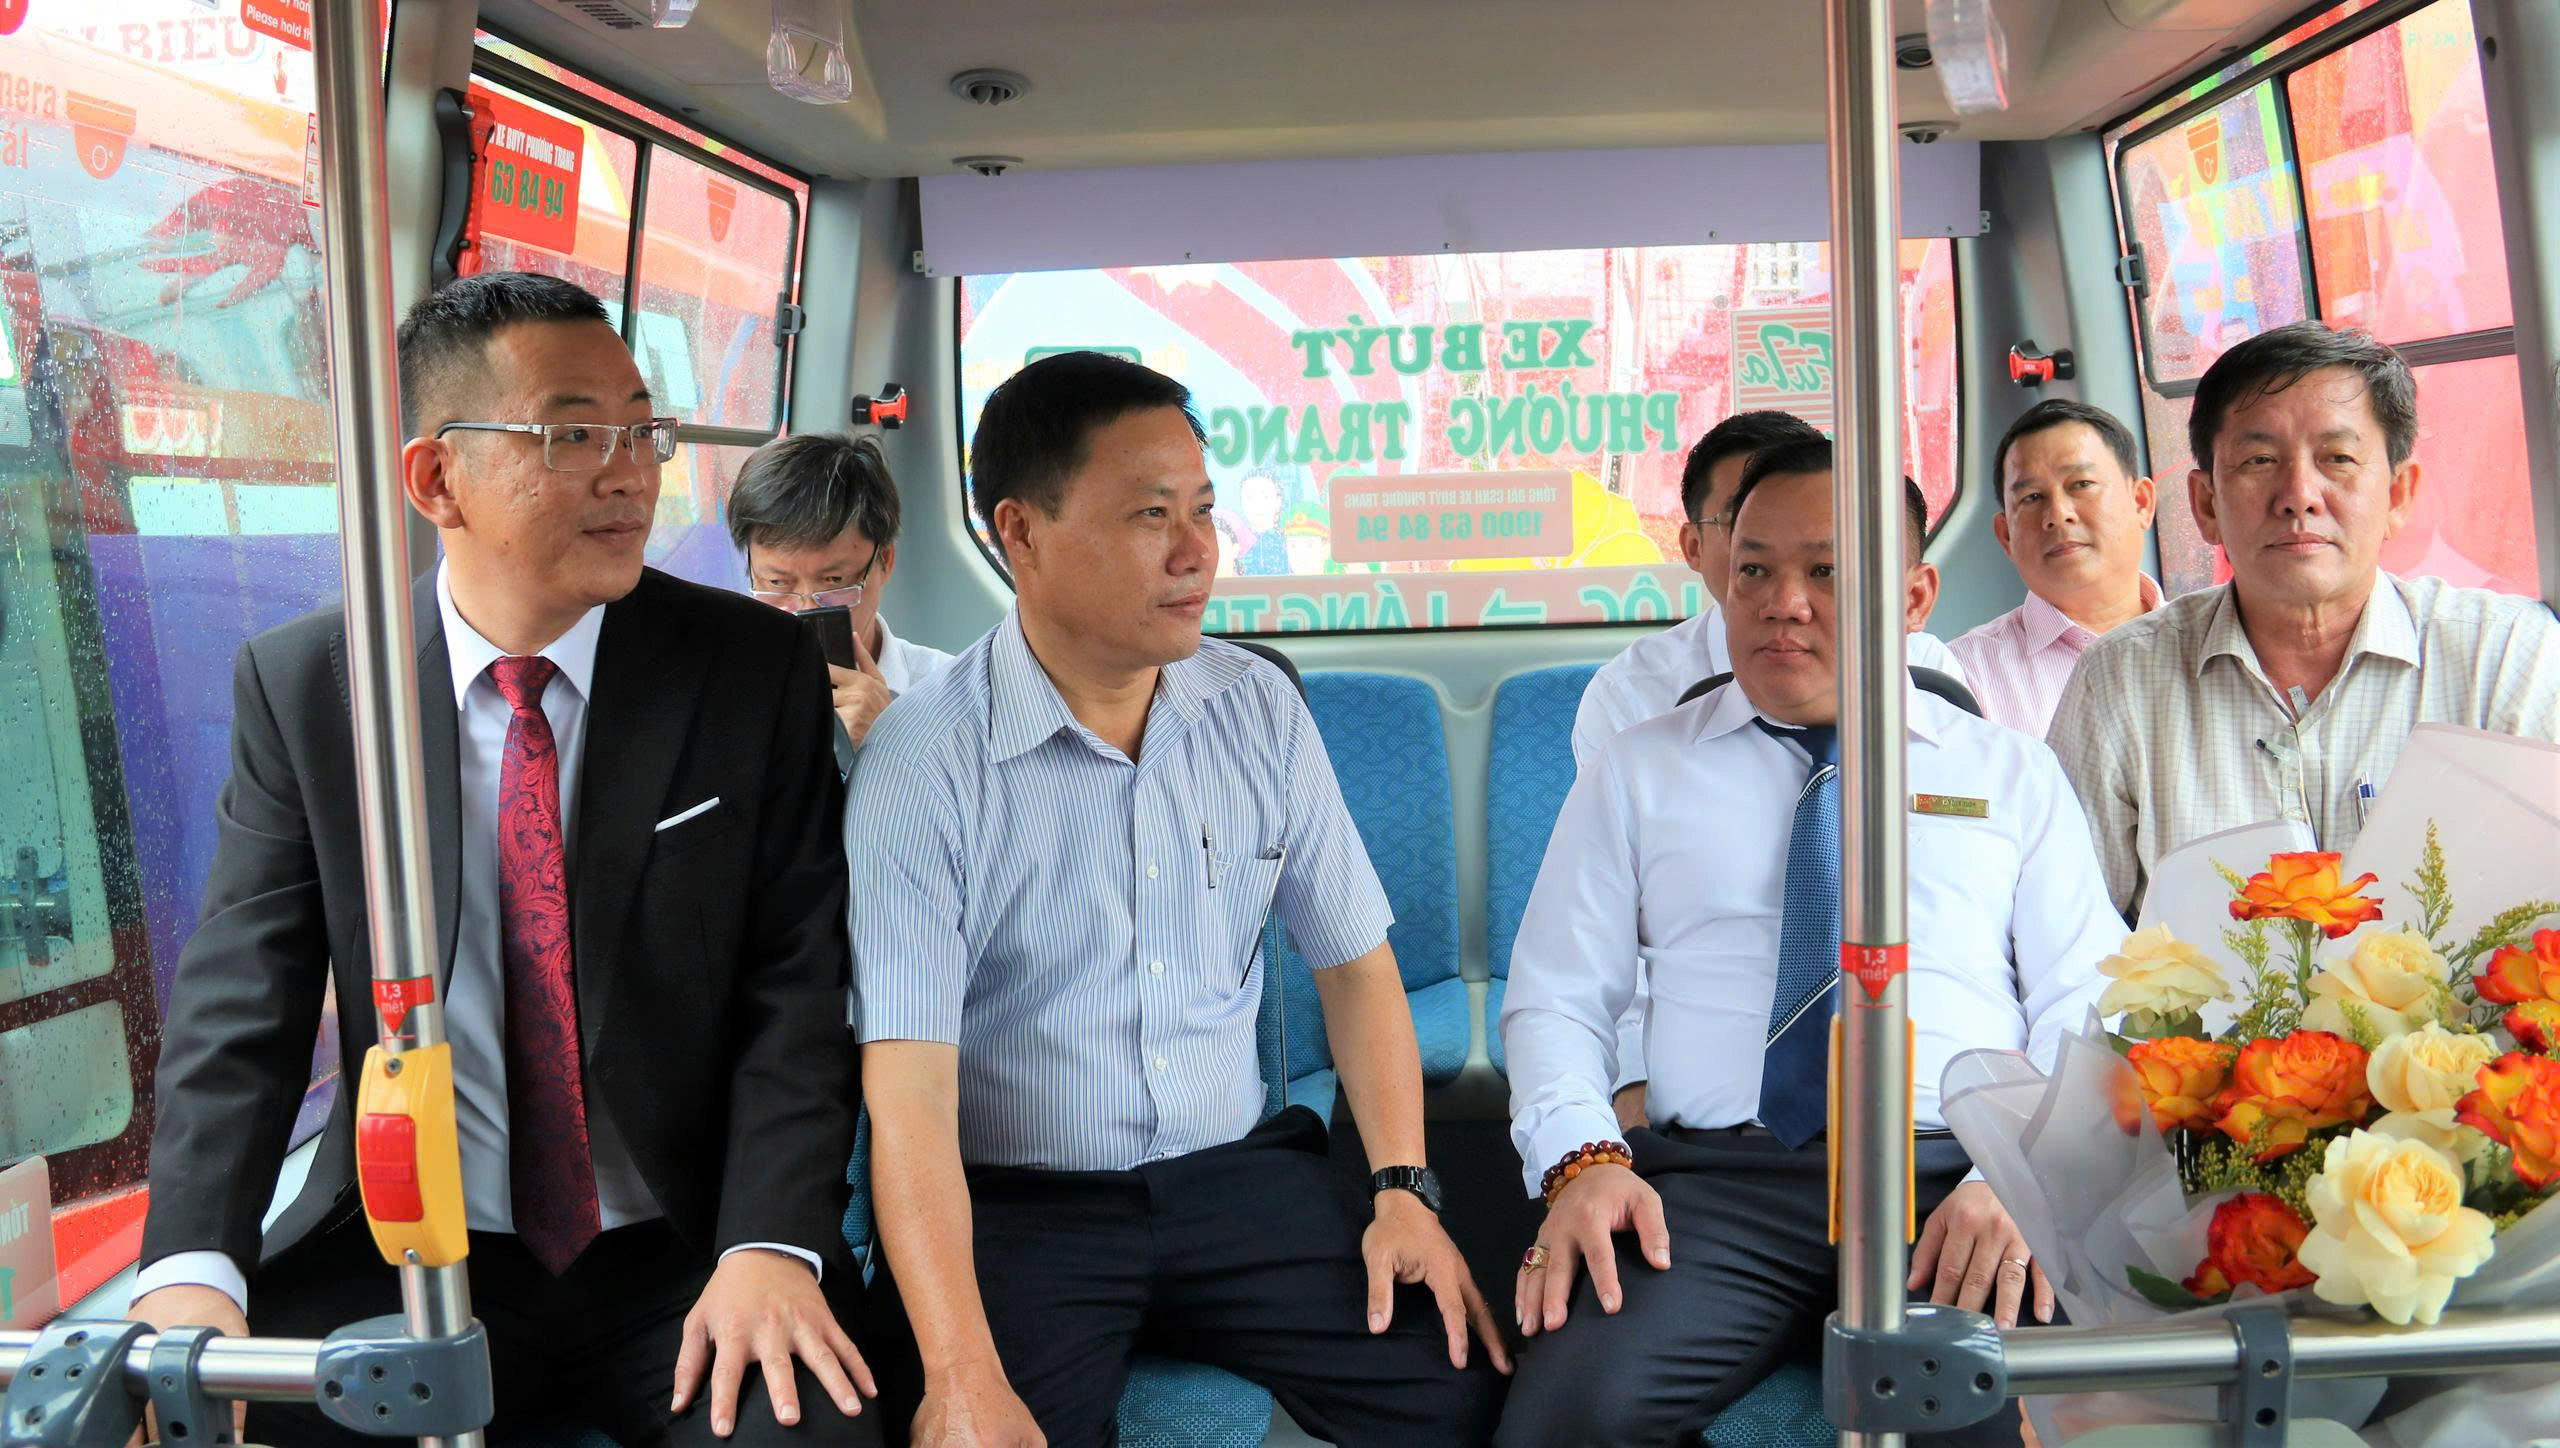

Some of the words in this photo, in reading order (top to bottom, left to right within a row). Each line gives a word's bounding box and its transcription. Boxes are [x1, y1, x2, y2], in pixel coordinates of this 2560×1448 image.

[246, 3, 279, 28] Please
[280, 17, 303, 38] hold
[303, 26, 313, 40] th
[495, 122, 506, 147] XE
[554, 144, 575, 173] TRANG
[491, 159, 515, 207] 63
[519, 168, 540, 214] 84
[544, 177, 566, 220] 94
[1862, 949, 1887, 967] 1,3
[380, 983, 402, 1000] 1,3
